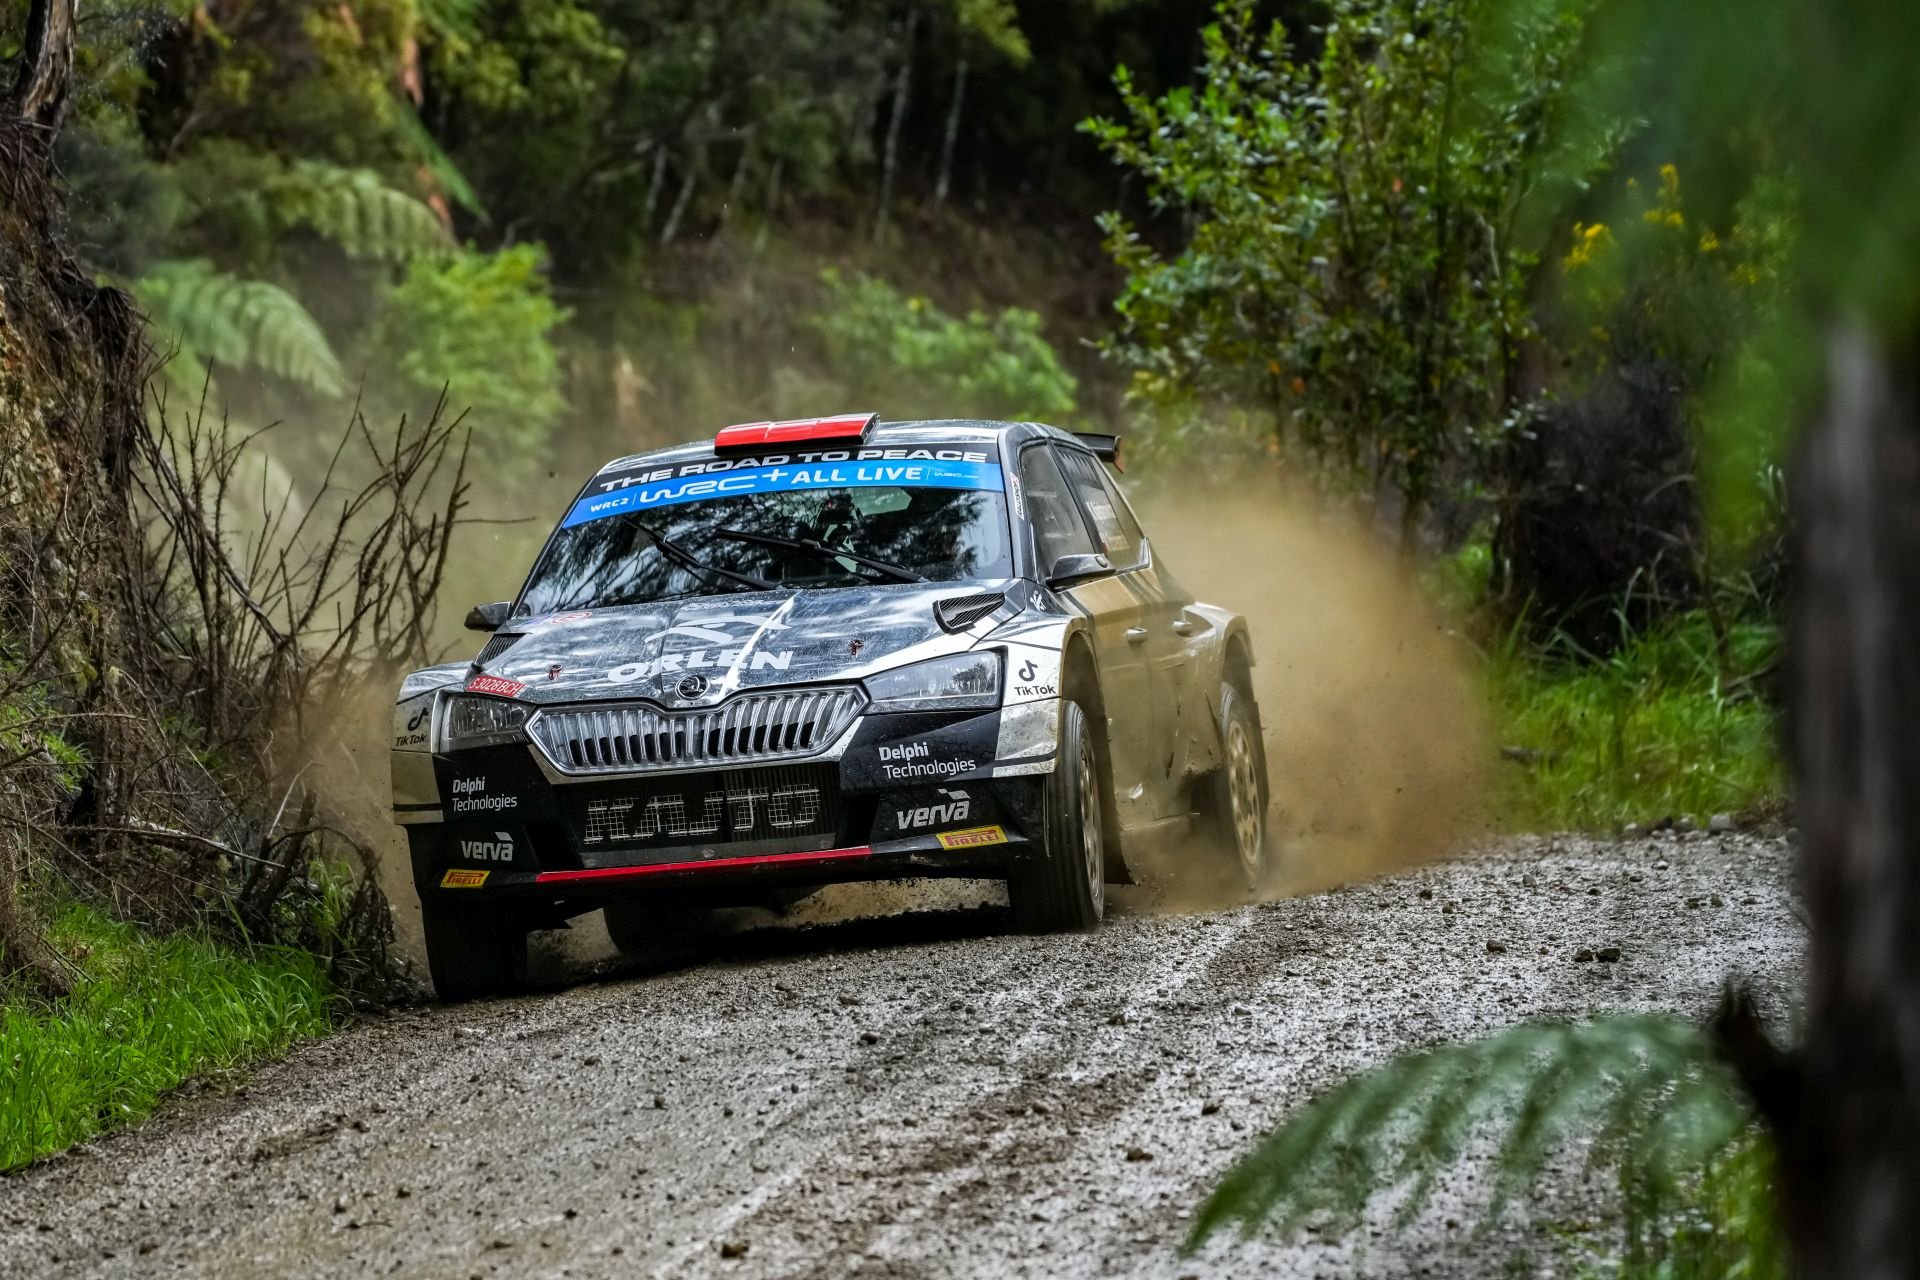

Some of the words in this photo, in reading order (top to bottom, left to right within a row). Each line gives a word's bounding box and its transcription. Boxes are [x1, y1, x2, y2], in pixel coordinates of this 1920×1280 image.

[600, 468, 674, 492] THE
[679, 455, 790, 477] ROAD
[798, 450, 850, 463] TO
[857, 449, 987, 463] PEACE
[590, 497, 629, 513] WRC2
[791, 469, 847, 485] ALL
[857, 467, 923, 481] LIVE
[607, 649, 794, 683] ORLEN
[1014, 684, 1056, 696] TikTok
[395, 733, 426, 746] TikTok
[878, 741, 929, 761] Delphi
[883, 757, 976, 779] Technologies
[452, 776, 486, 795] Delphi
[452, 793, 518, 812] Technologies
[897, 799, 970, 830] verva
[945, 829, 1000, 847] PIRELLI
[460, 839, 514, 861] verva
[446, 871, 486, 885] PIRELLI
